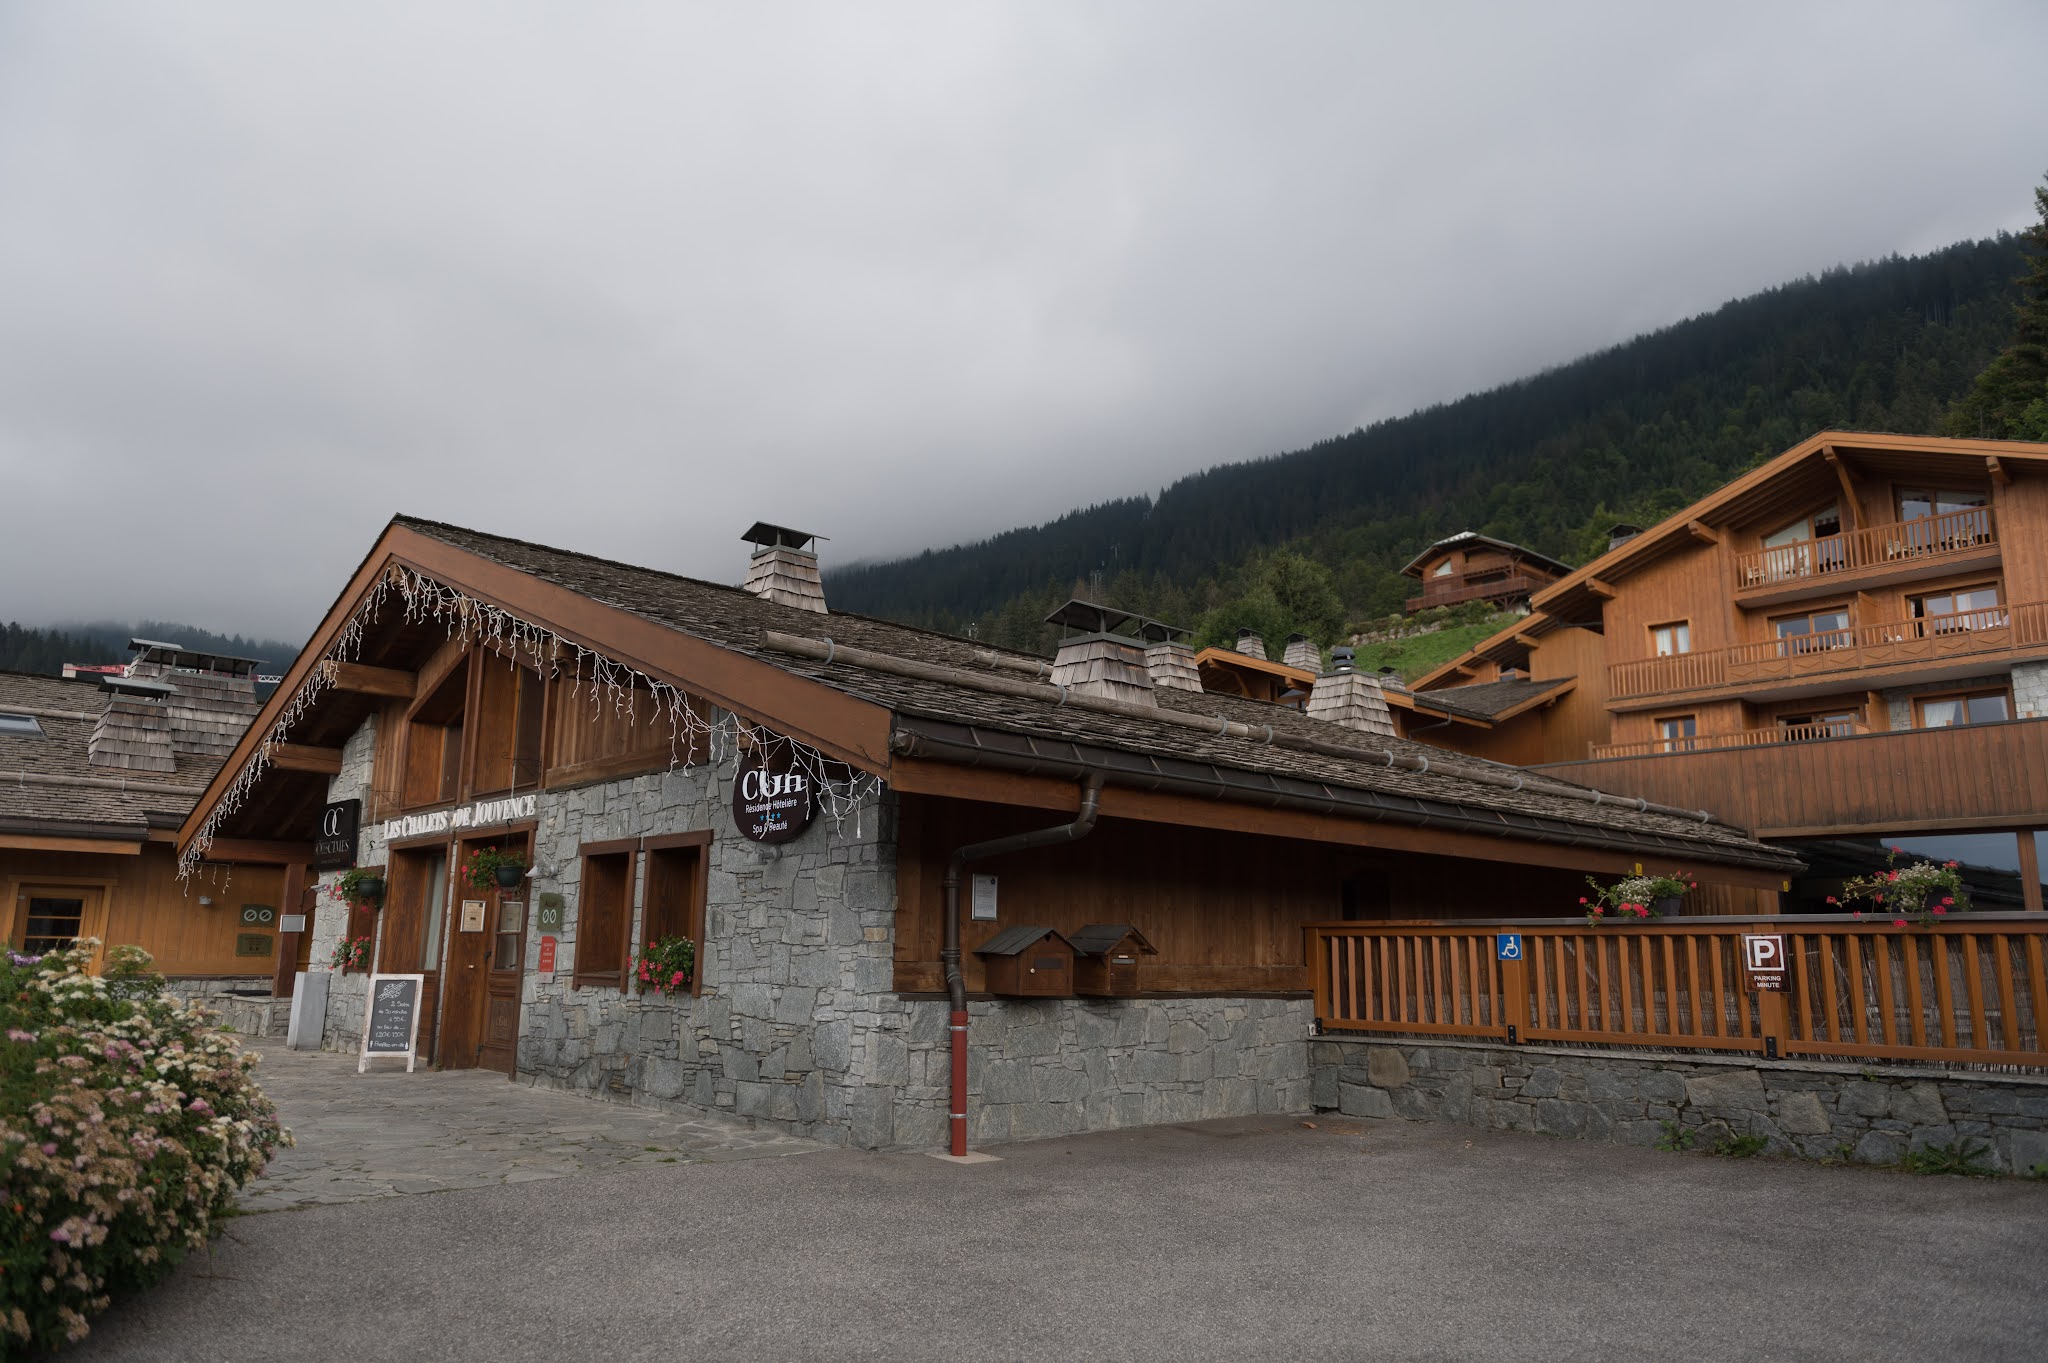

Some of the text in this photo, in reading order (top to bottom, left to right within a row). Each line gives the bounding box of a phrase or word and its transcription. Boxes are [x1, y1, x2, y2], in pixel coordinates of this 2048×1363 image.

[773, 798, 797, 809] Hôtelière
[384, 795, 536, 839] LES CHALETS DE JOUVENCE
[753, 824, 763, 835] Spa
[769, 820, 788, 832] Beauté
[1753, 940, 1775, 966] P
